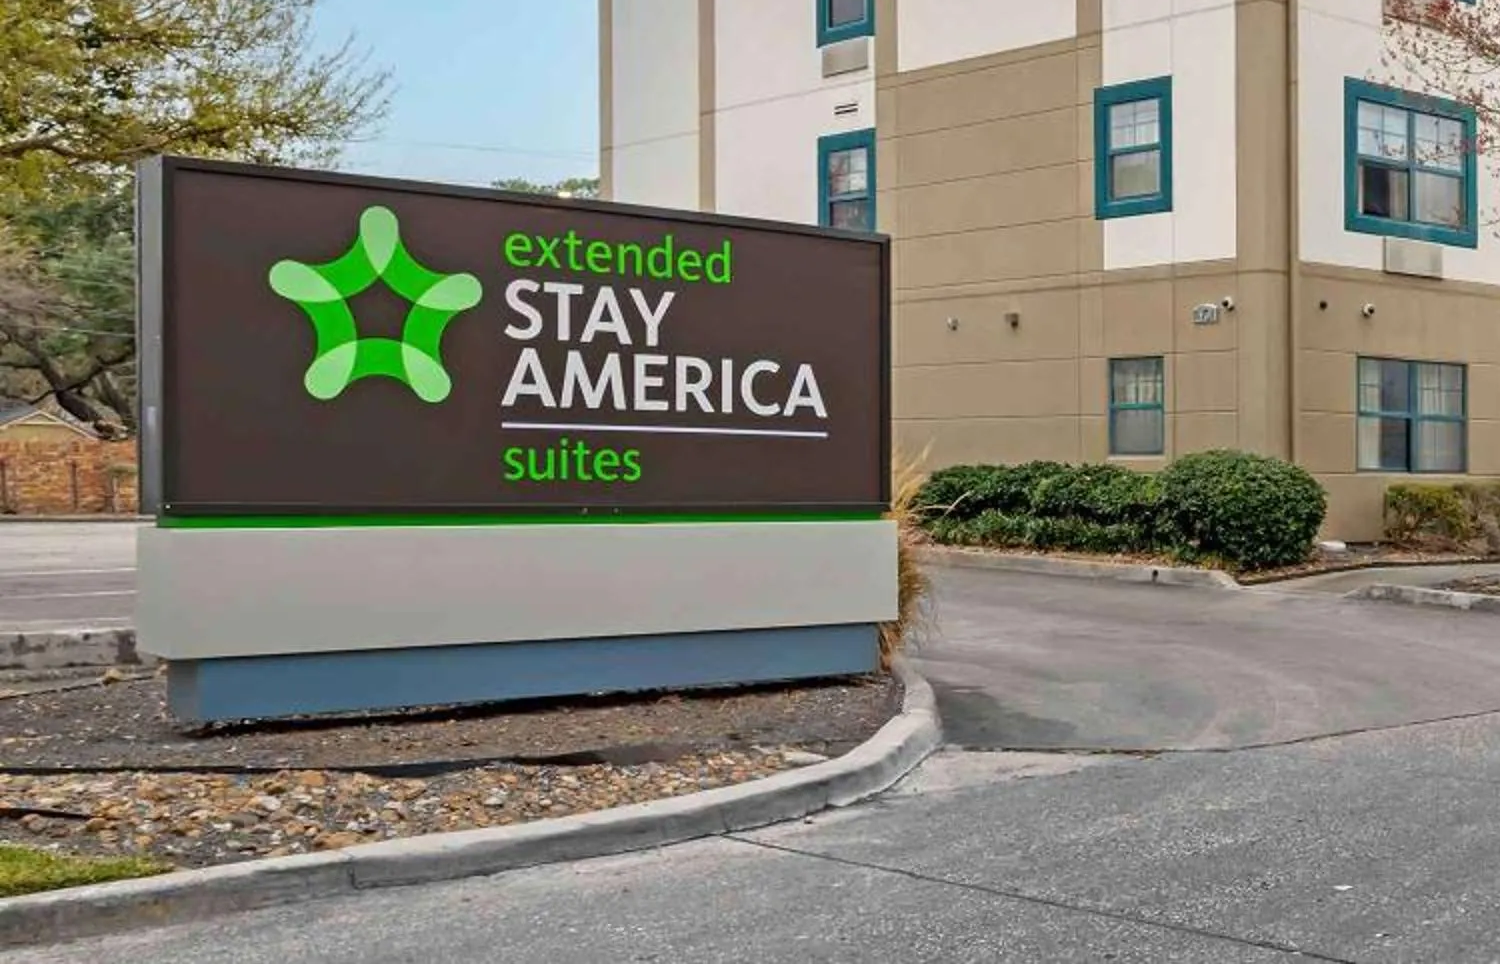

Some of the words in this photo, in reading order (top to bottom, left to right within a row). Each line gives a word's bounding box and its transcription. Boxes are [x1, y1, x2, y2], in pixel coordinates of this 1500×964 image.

[504, 230, 732, 283] extended
[503, 279, 675, 347] STAY
[501, 348, 828, 418] AMERICA
[503, 438, 642, 481] suites
